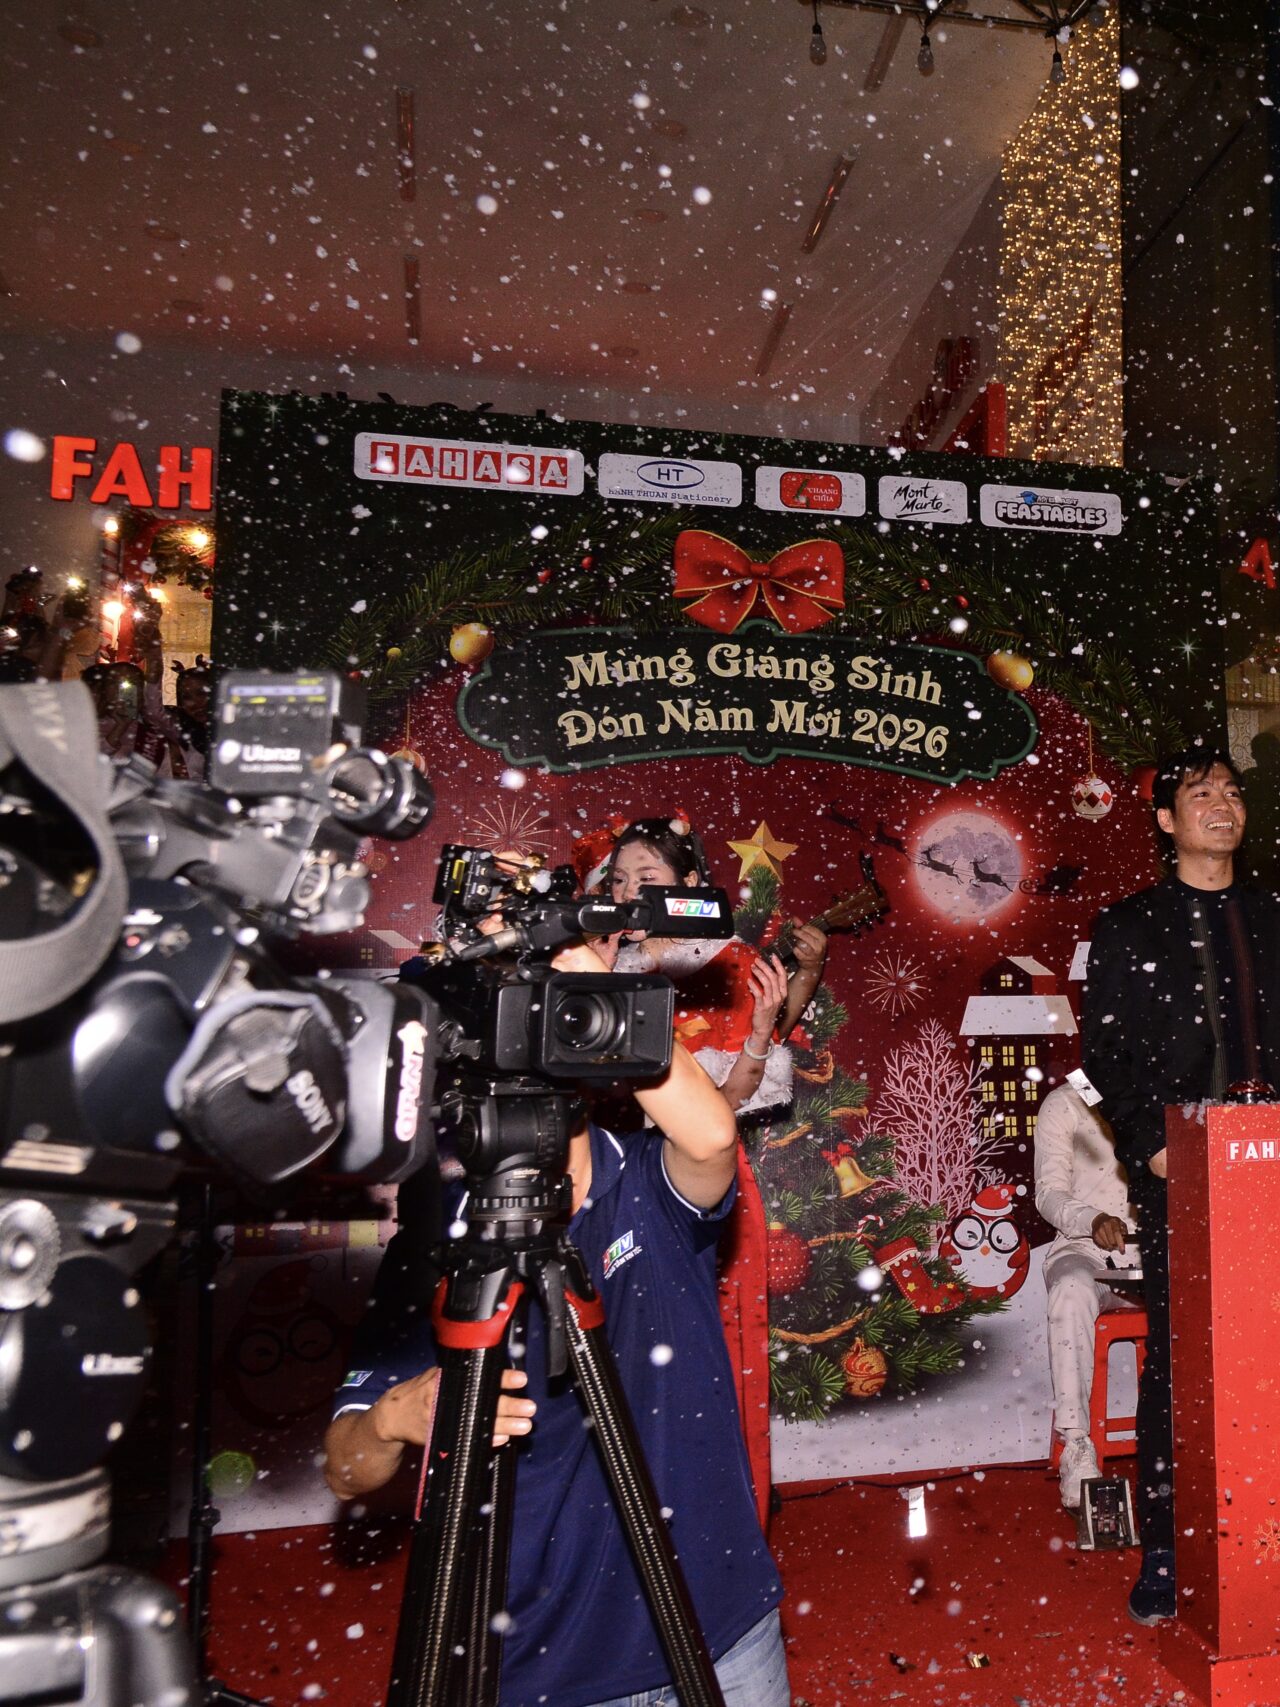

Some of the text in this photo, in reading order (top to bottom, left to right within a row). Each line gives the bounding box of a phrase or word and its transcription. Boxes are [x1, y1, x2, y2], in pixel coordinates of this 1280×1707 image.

[371, 442, 568, 488] FAHASA
[657, 467, 685, 482] HT
[636, 490, 668, 499] THUAN
[671, 492, 733, 505] Stationery
[894, 482, 935, 500] Mont
[900, 495, 944, 513] Marte
[995, 501, 1108, 527] FEASTABLES
[565, 643, 943, 706] Mừng Giáng Sinh
[557, 699, 950, 759] Đón Năm Mới 2026
[592, 904, 617, 913] SONY
[671, 899, 716, 917] HTV
[286, 1069, 334, 1134] SONY
[603, 1231, 634, 1275] TV
